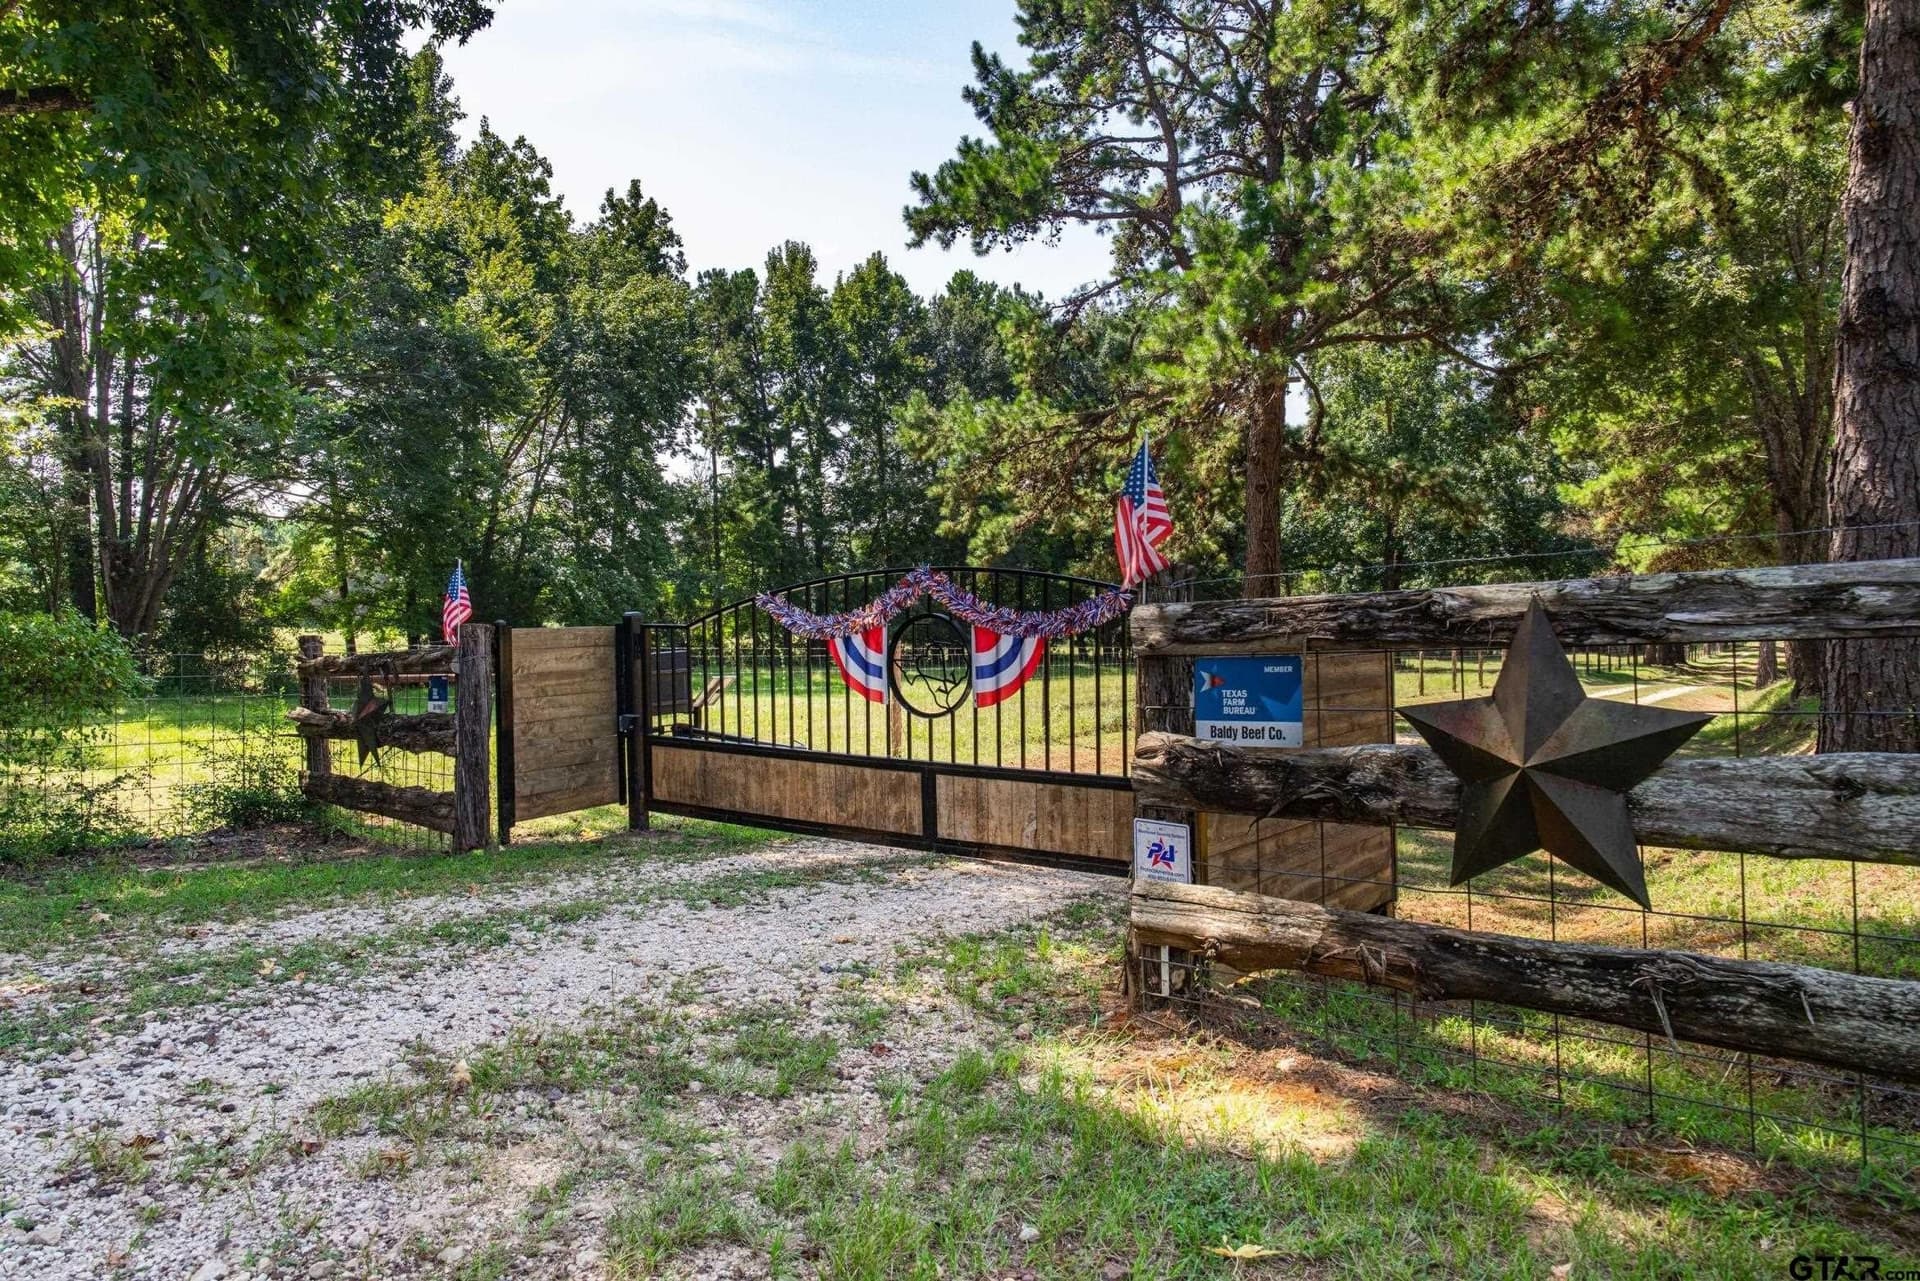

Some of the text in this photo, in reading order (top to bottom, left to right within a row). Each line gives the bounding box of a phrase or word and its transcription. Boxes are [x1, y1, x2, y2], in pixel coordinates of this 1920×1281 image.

[1263, 665, 1293, 673] MEMBER
[1221, 689, 1248, 698] TEXAS
[1222, 698, 1246, 706] FARM
[1223, 706, 1256, 715] BUREAU
[1210, 725, 1286, 741] Baldy Beef Co.
